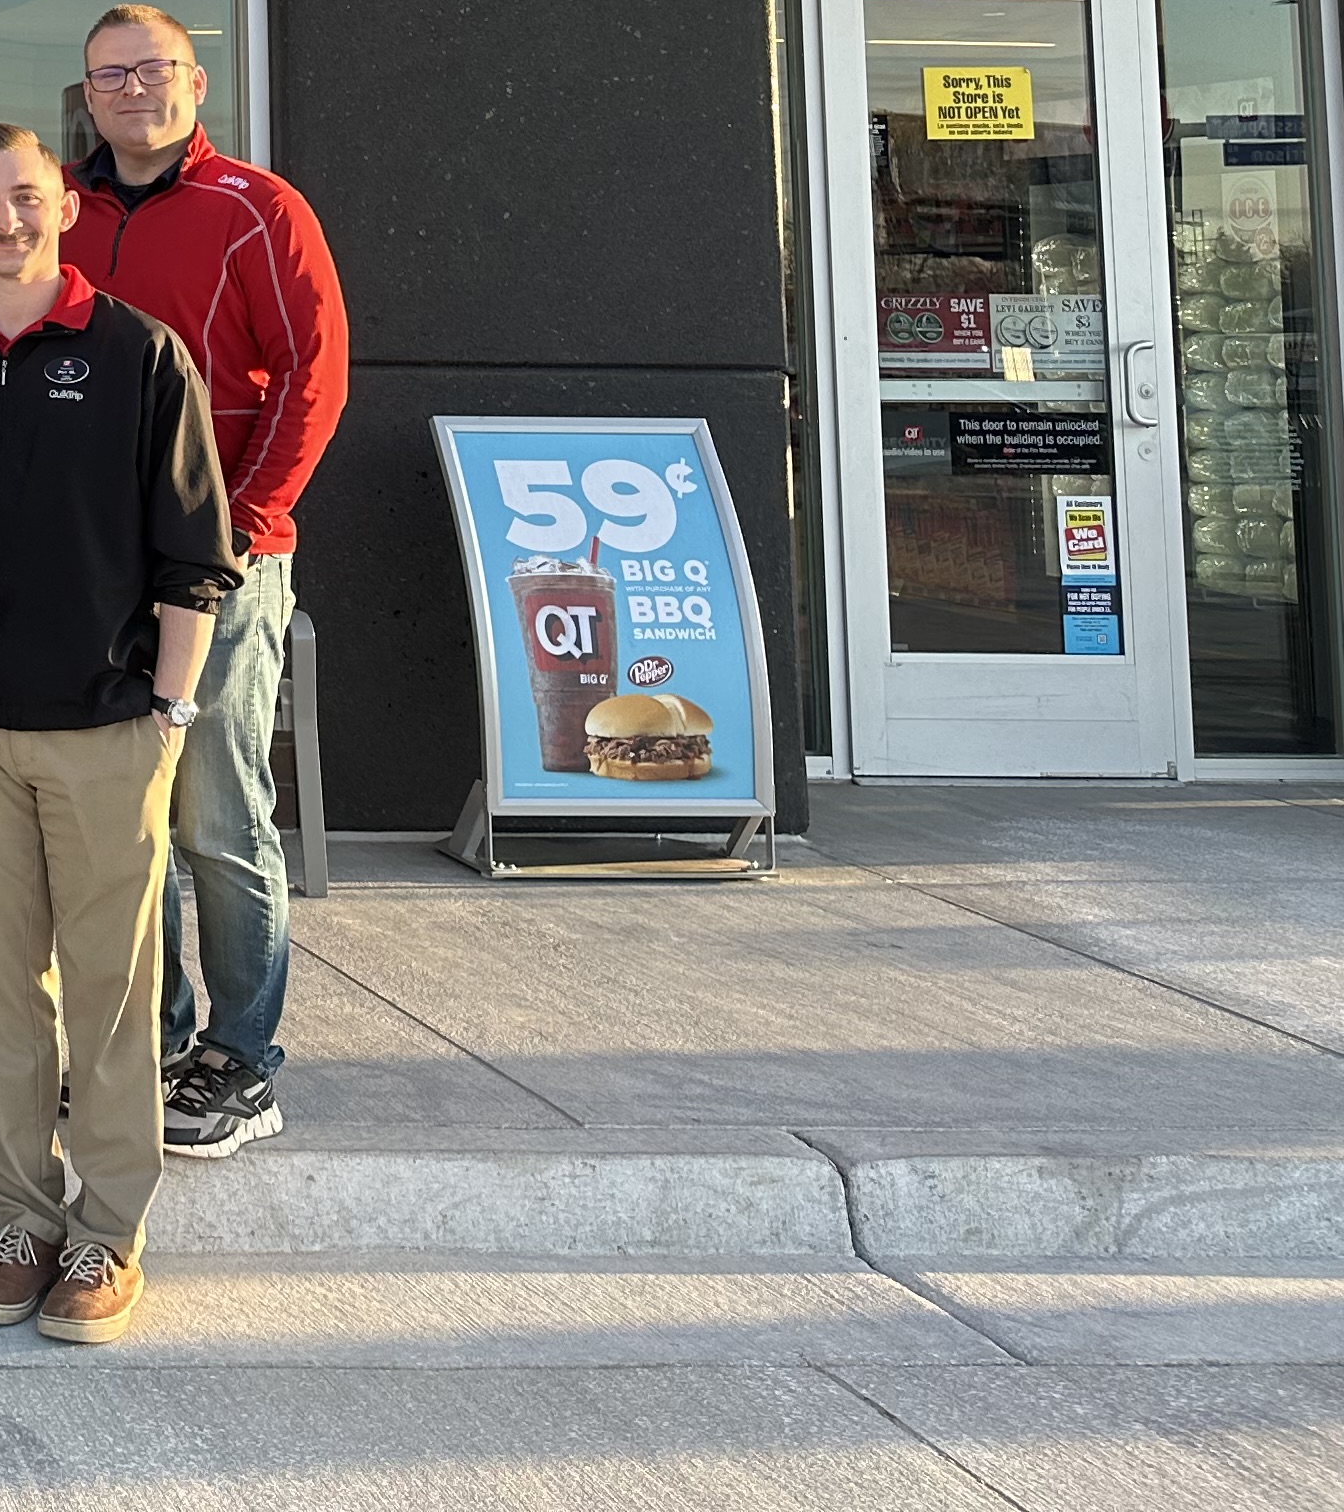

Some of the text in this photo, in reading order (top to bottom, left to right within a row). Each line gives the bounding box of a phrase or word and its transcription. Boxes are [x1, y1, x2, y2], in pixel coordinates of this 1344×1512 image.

[942, 75, 1012, 90] Sorry, This
[953, 91, 1003, 104] Store is
[938, 106, 1020, 119] NOT OPEN Yet
[1235, 199, 1266, 219] ICE
[881, 297, 944, 310] GRIZZLY
[950, 299, 984, 312] SAVE
[1062, 299, 1102, 312] SAVE
[960, 313, 976, 328] $1
[49, 389, 83, 401] QuikTrip
[959, 419, 1099, 430] This door to remain unlocked
[905, 428, 919, 439] QT
[956, 434, 1103, 446] when the building is occupied.
[1072, 528, 1097, 539] We
[1068, 537, 1104, 551] Card
[621, 560, 676, 582] BIG
[628, 596, 714, 628] BBQ
[535, 605, 596, 659] QT
[633, 628, 716, 640] SANDWICH
[644, 659, 659, 670] Dr
[580, 674, 598, 684] BIG
[629, 663, 668, 686] Pepper
